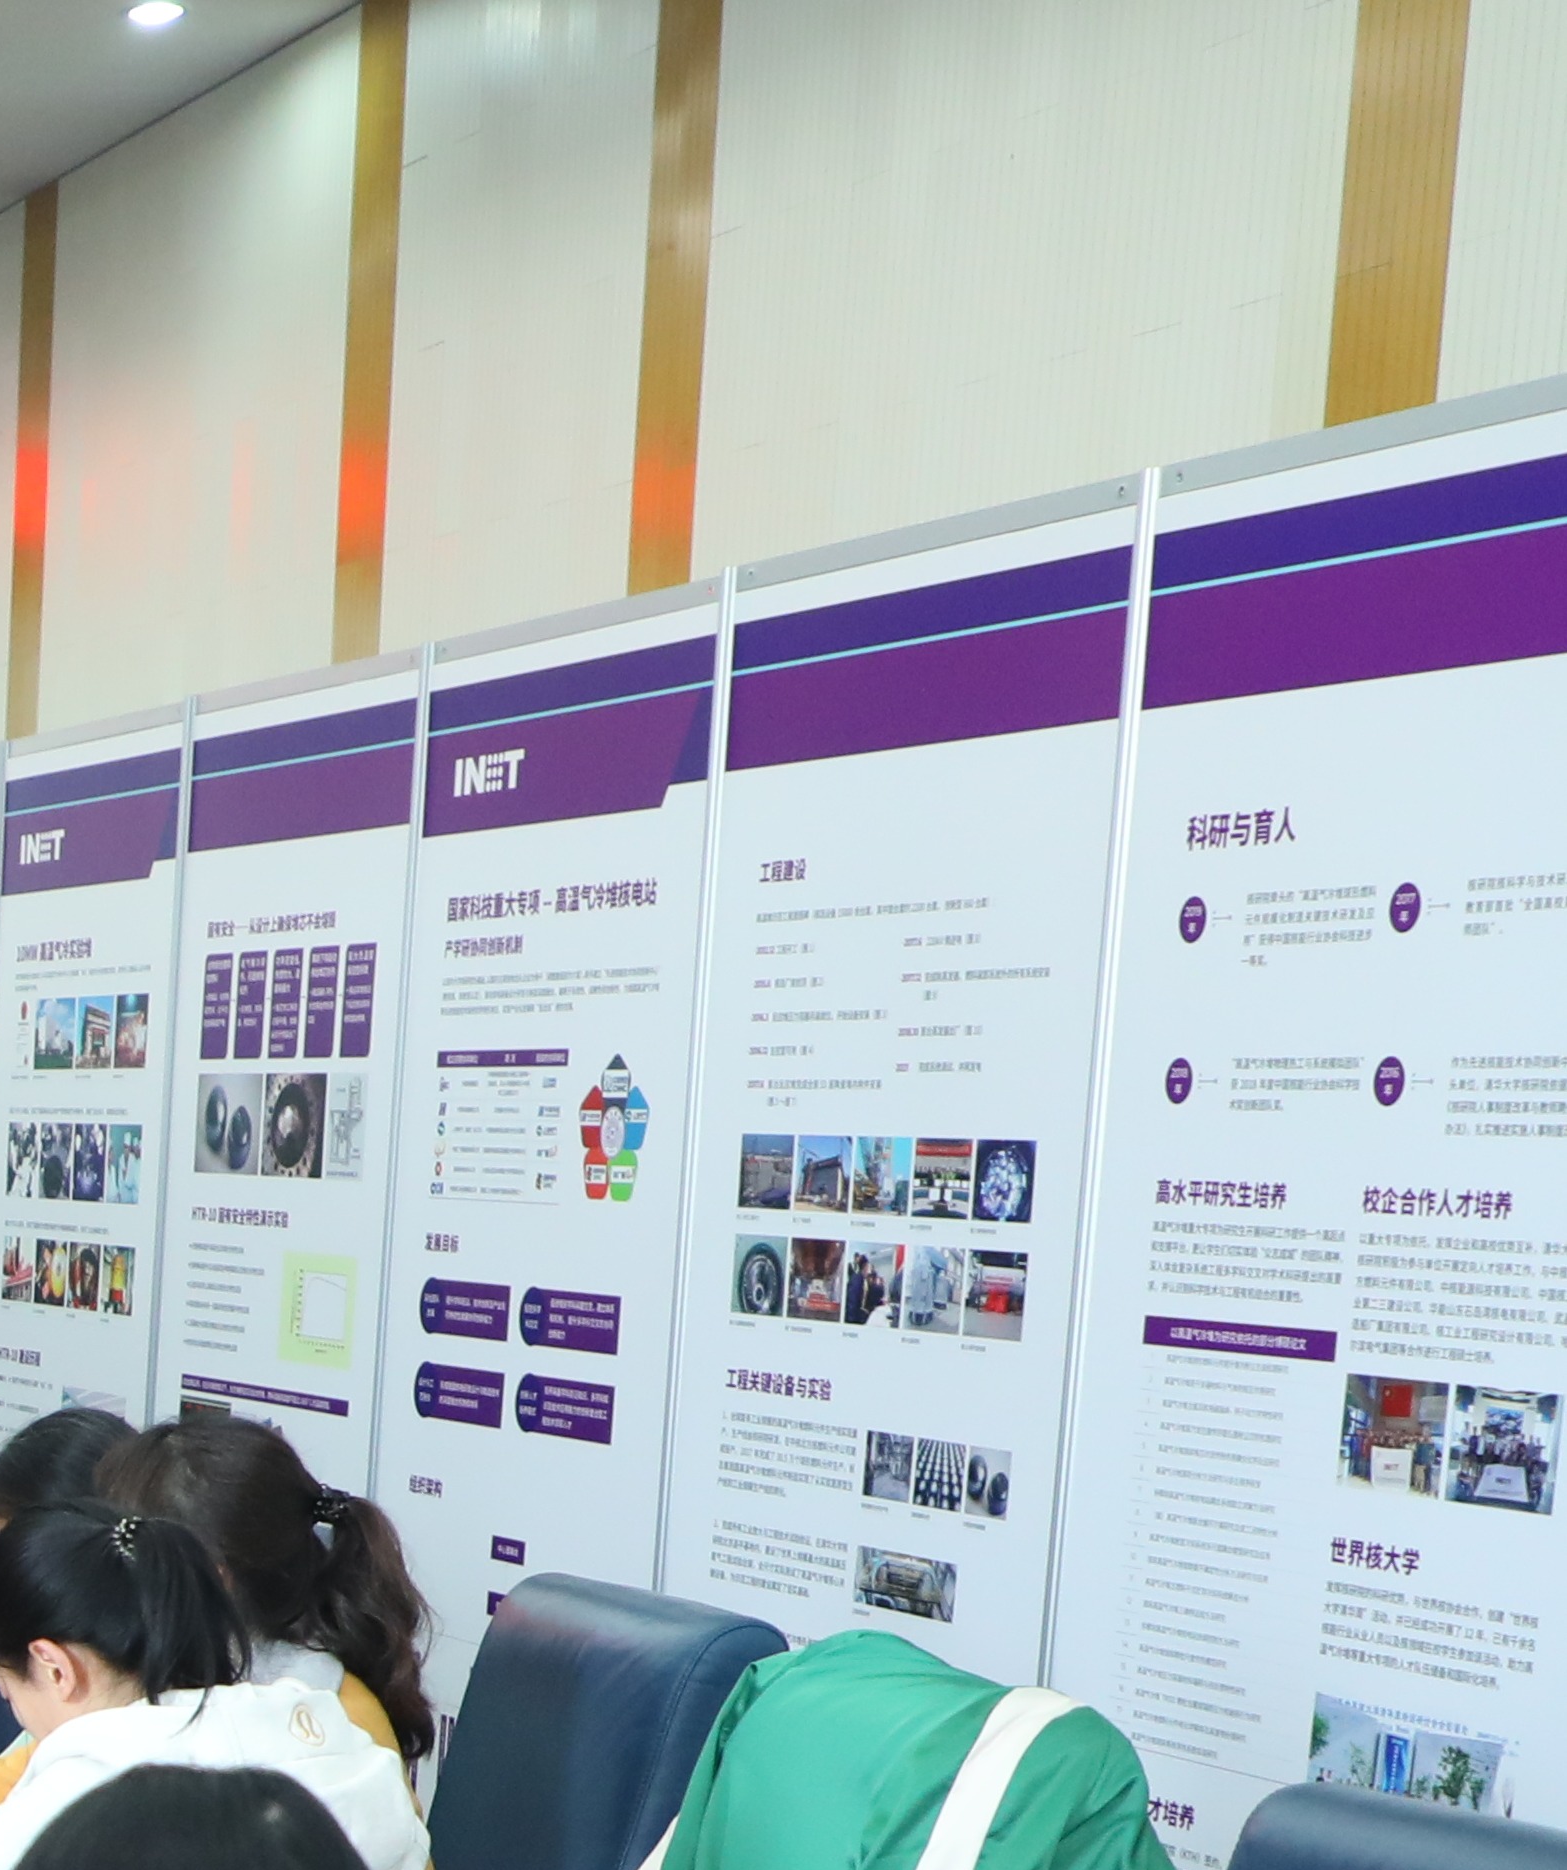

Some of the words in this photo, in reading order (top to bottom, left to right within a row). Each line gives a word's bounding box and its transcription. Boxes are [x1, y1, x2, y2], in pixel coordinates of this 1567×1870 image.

[453, 747, 526, 798] INET
[1186, 805, 1297, 852] 科研与育人
[19, 829, 66, 866] INET
[759, 858, 807, 884] 工程建设
[1156, 1178, 1287, 1210] 高水平研究生培养
[1362, 1186, 1513, 1219] 校企合作人才培养
[424, 1232, 460, 1254] 发展目标
[725, 1367, 833, 1402] 工程关键设备与实验
[1330, 1536, 1421, 1576] 世界核大学
